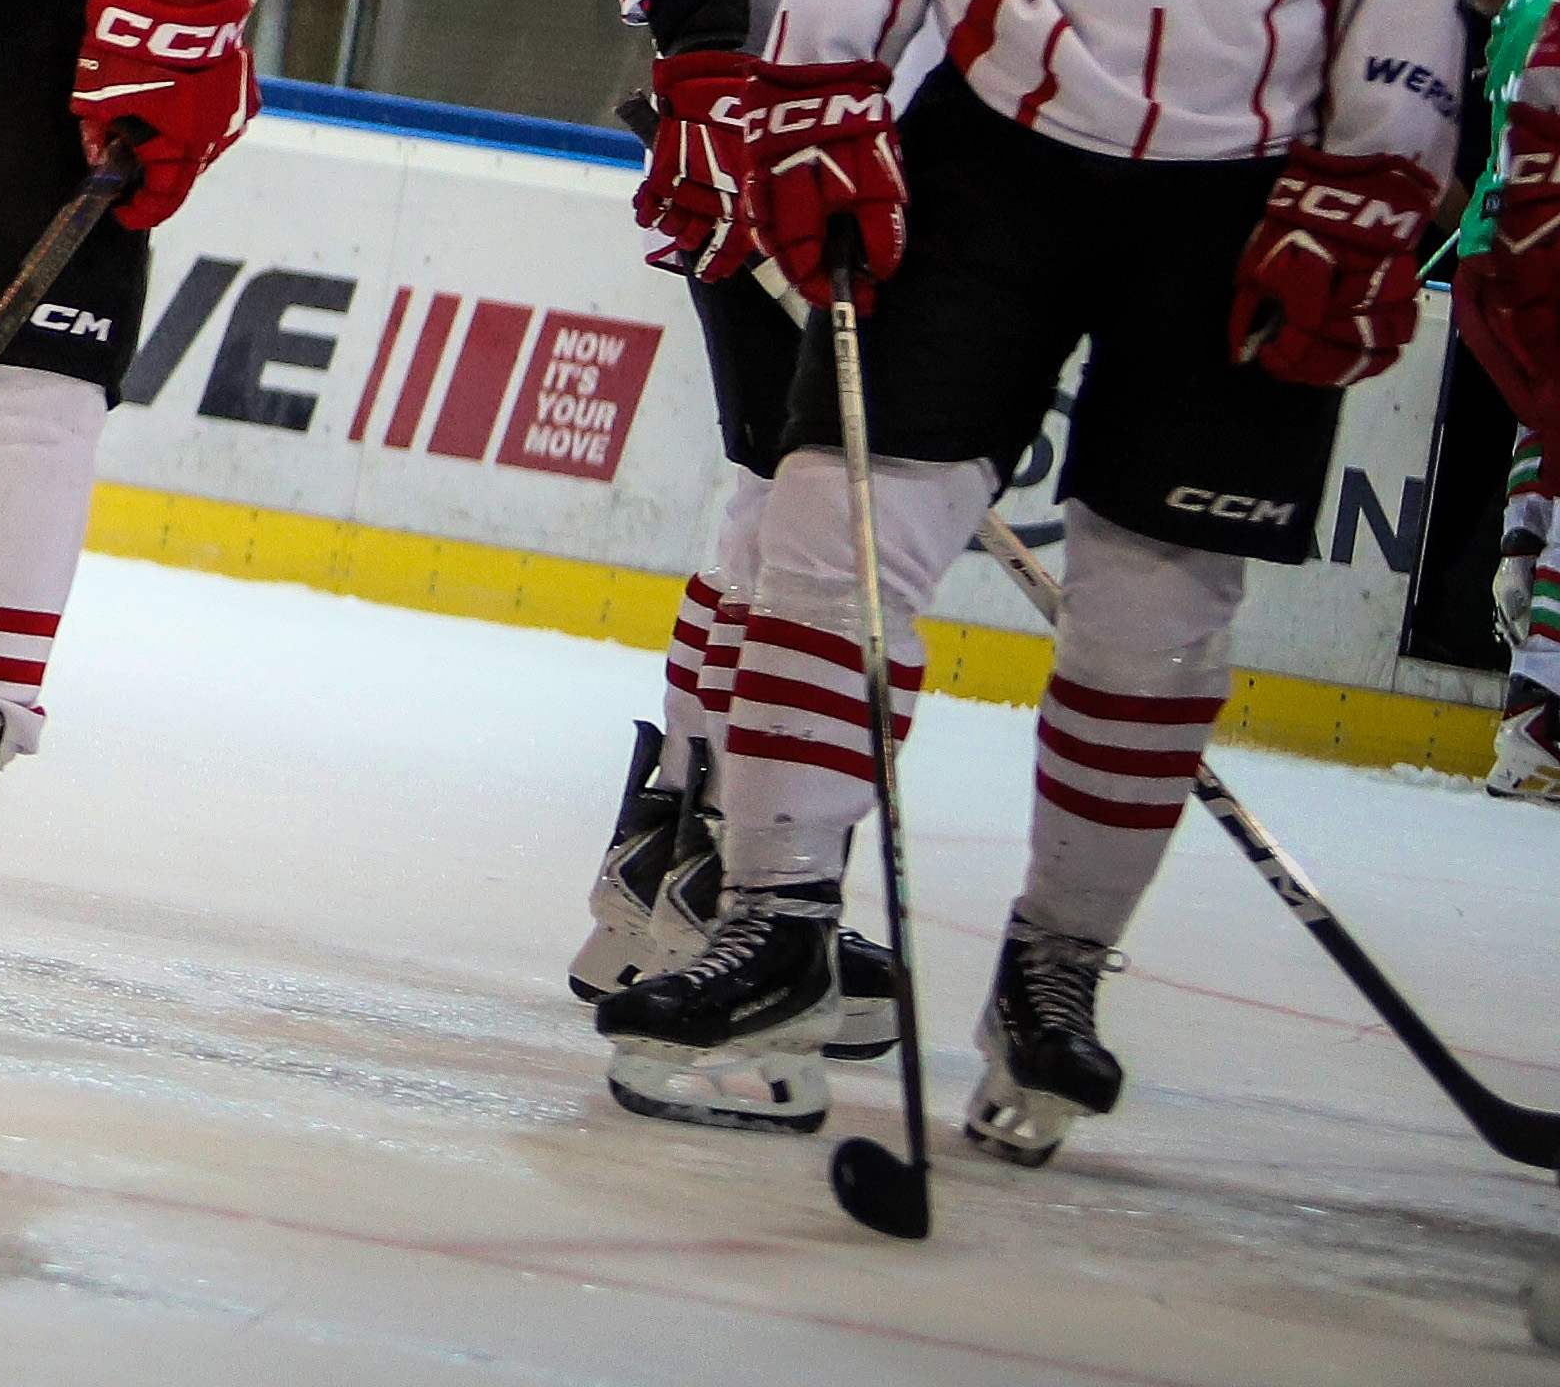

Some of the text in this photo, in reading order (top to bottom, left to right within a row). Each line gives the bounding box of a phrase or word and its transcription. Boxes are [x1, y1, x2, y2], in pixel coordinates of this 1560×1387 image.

[96, 6, 248, 61] CCM
[744, 92, 886, 145] CCM
[1267, 176, 1420, 241] CCM
[28, 303, 113, 344] CM
[553, 328, 626, 366] NOW
[545, 362, 597, 392] IT'S
[536, 392, 615, 428] YOUR
[524, 426, 610, 464] MOVE
[1165, 486, 1298, 527] CCM
